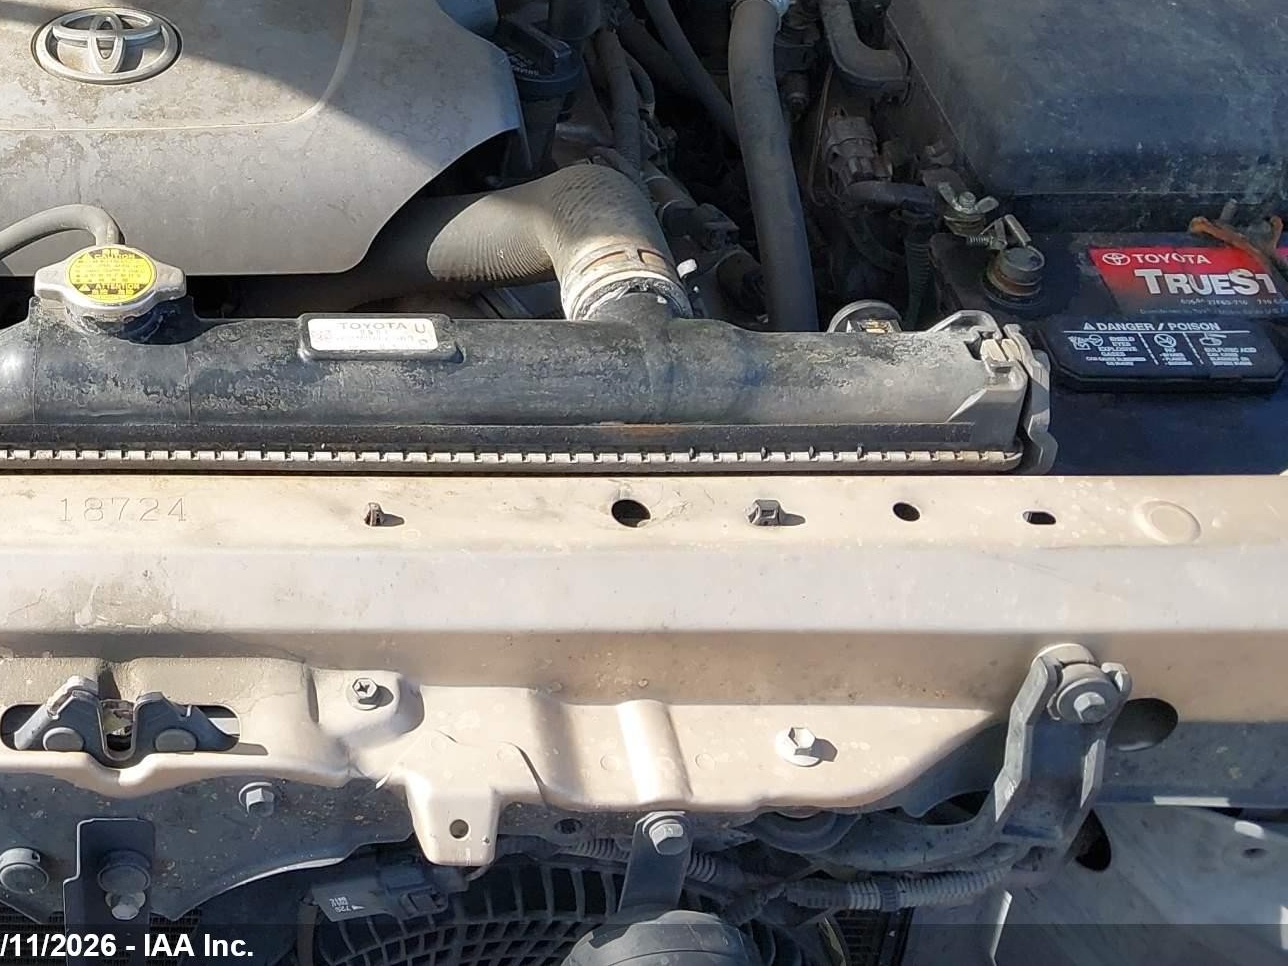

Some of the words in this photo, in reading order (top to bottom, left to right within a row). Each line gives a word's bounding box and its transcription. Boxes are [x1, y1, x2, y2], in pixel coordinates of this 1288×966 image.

[1132, 253, 1212, 265] TOYOTA
[339, 322, 408, 330] TOYOTA
[1096, 322, 1154, 332] DANGER
[1167, 322, 1221, 332] POISON
[59, 497, 187, 522] 18724
